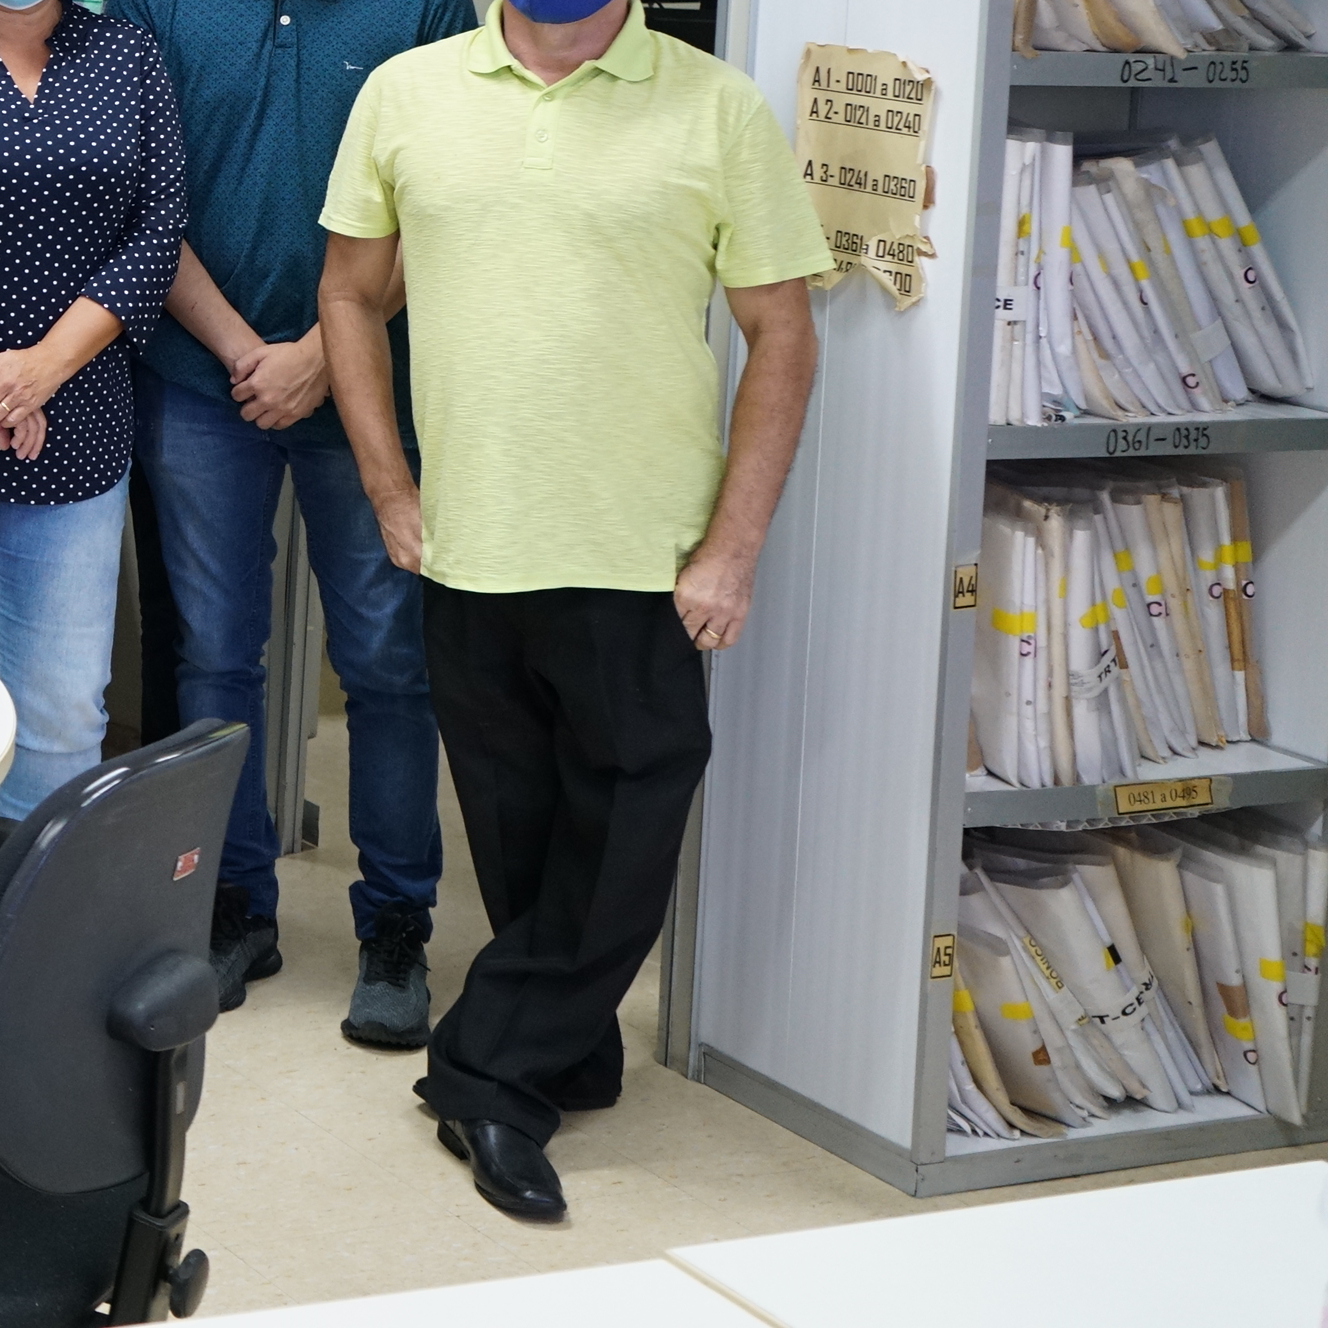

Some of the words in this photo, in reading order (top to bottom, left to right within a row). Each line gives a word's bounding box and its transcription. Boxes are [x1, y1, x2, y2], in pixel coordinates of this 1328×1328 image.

[811, 65, 822, 88] A
[845, 70, 878, 95] 0001
[881, 82, 889, 96] a
[892, 77, 924, 102] 0120
[809, 96, 820, 119] A
[844, 102, 870, 126] 0121
[873, 114, 881, 127] a
[885, 109, 922, 134] 0240
[803, 159, 815, 181] A
[838, 166, 868, 190] 0241
[871, 178, 879, 191] a
[882, 174, 917, 199] 0360
[834, 229, 864, 254] 0361
[875, 239, 916, 264] 0480
[955, 575, 977, 599] A4
[1127, 790, 1156, 807] 0481
[1160, 792, 1167, 803] a
[1169, 785, 1199, 802] 0495
[932, 945, 953, 969] A5
